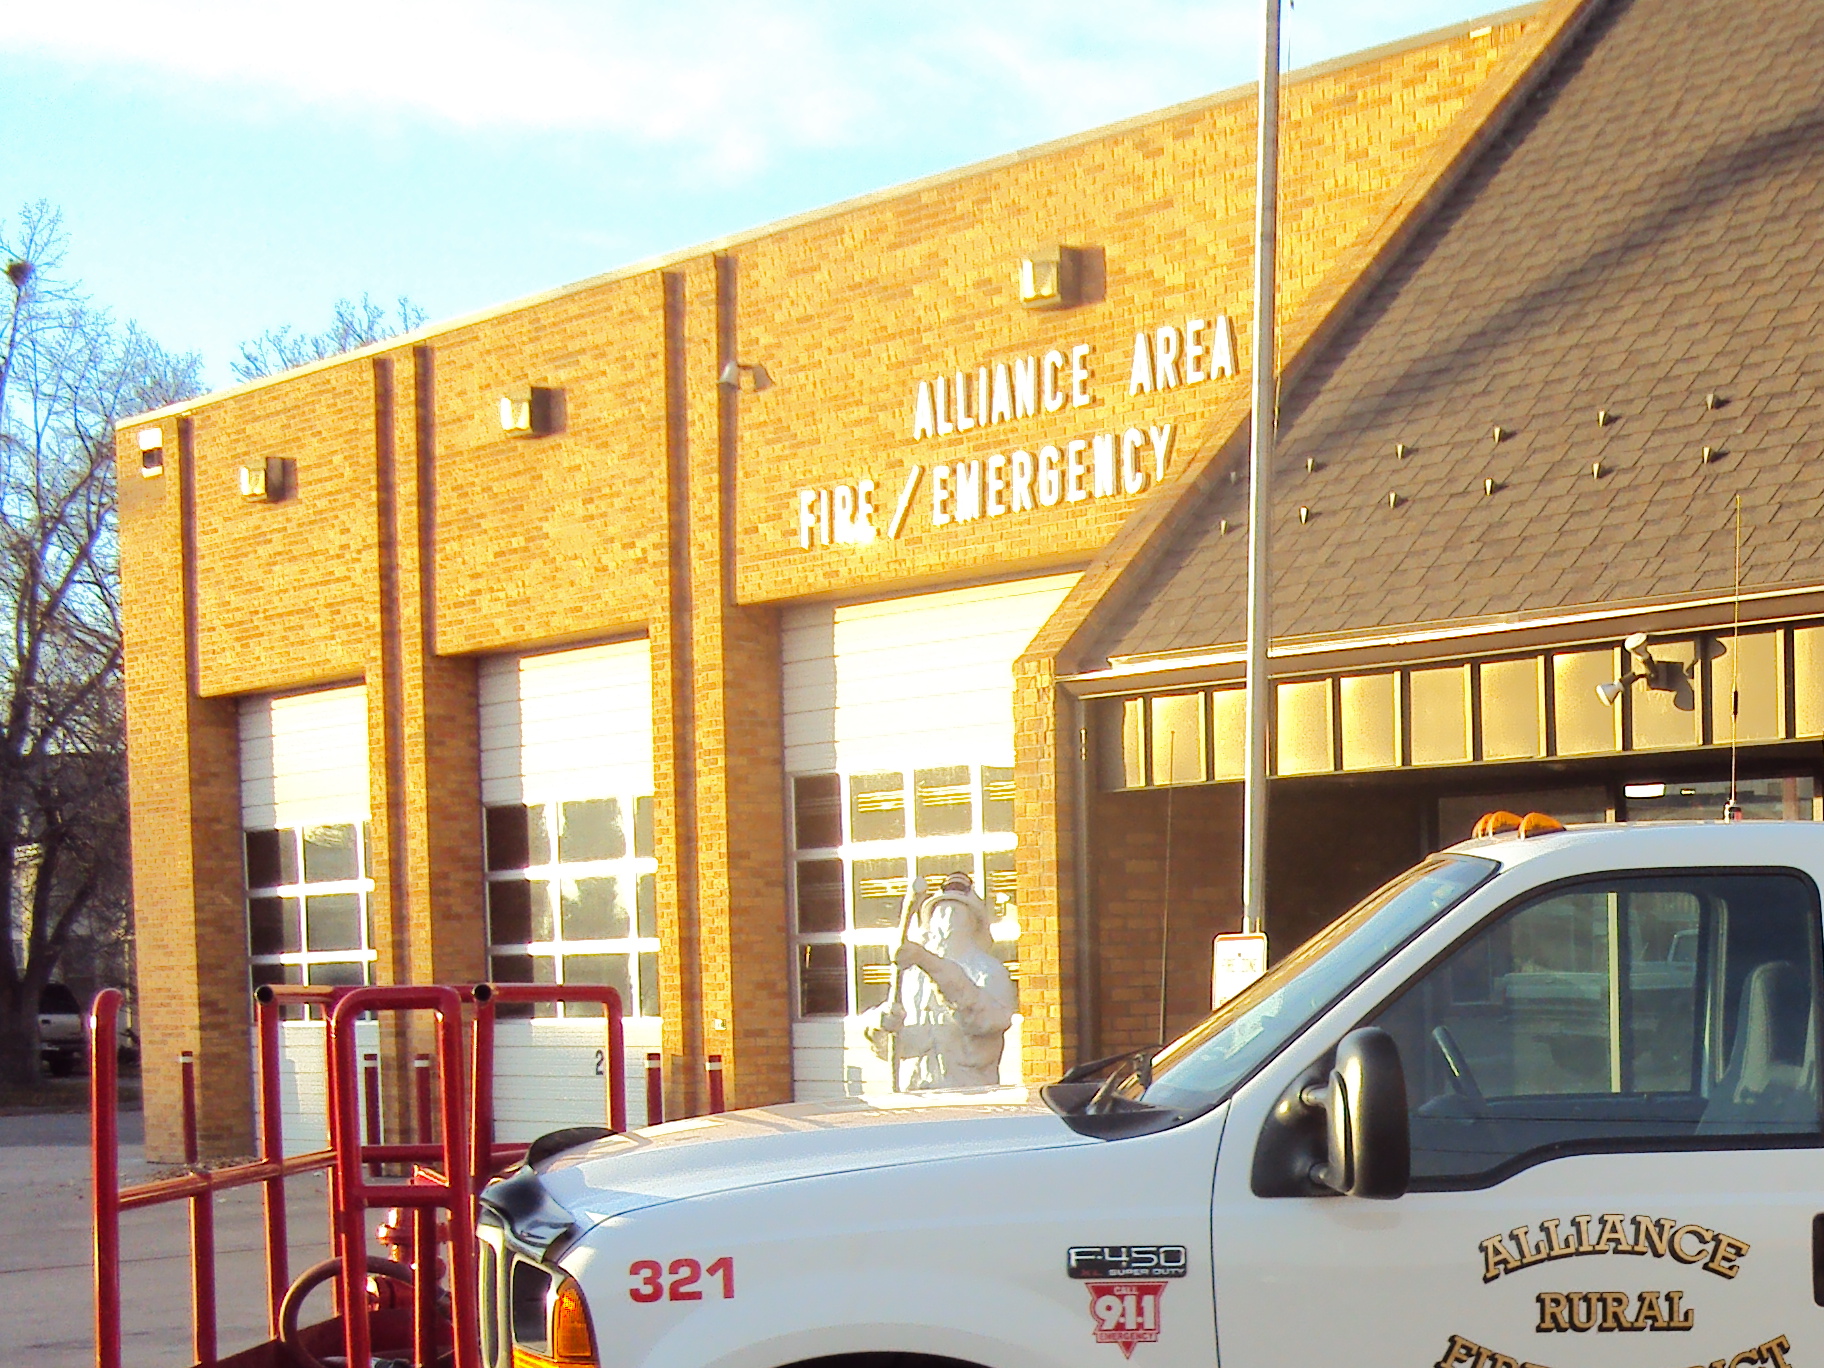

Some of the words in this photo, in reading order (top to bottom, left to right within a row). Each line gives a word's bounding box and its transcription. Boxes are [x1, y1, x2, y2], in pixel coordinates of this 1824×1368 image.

[913, 343, 1091, 440] ALLIANCE
[1129, 314, 1237, 397] AREA
[595, 1049, 605, 1076] 2
[1479, 1213, 1751, 1284] ALLIANCE
[629, 1256, 735, 1303] 321
[1108, 1268, 1150, 1277] SUPER
[1152, 1268, 1185, 1276] DUTY
[1113, 1286, 1140, 1295] CALL
[1535, 1291, 1695, 1332] RURAL
